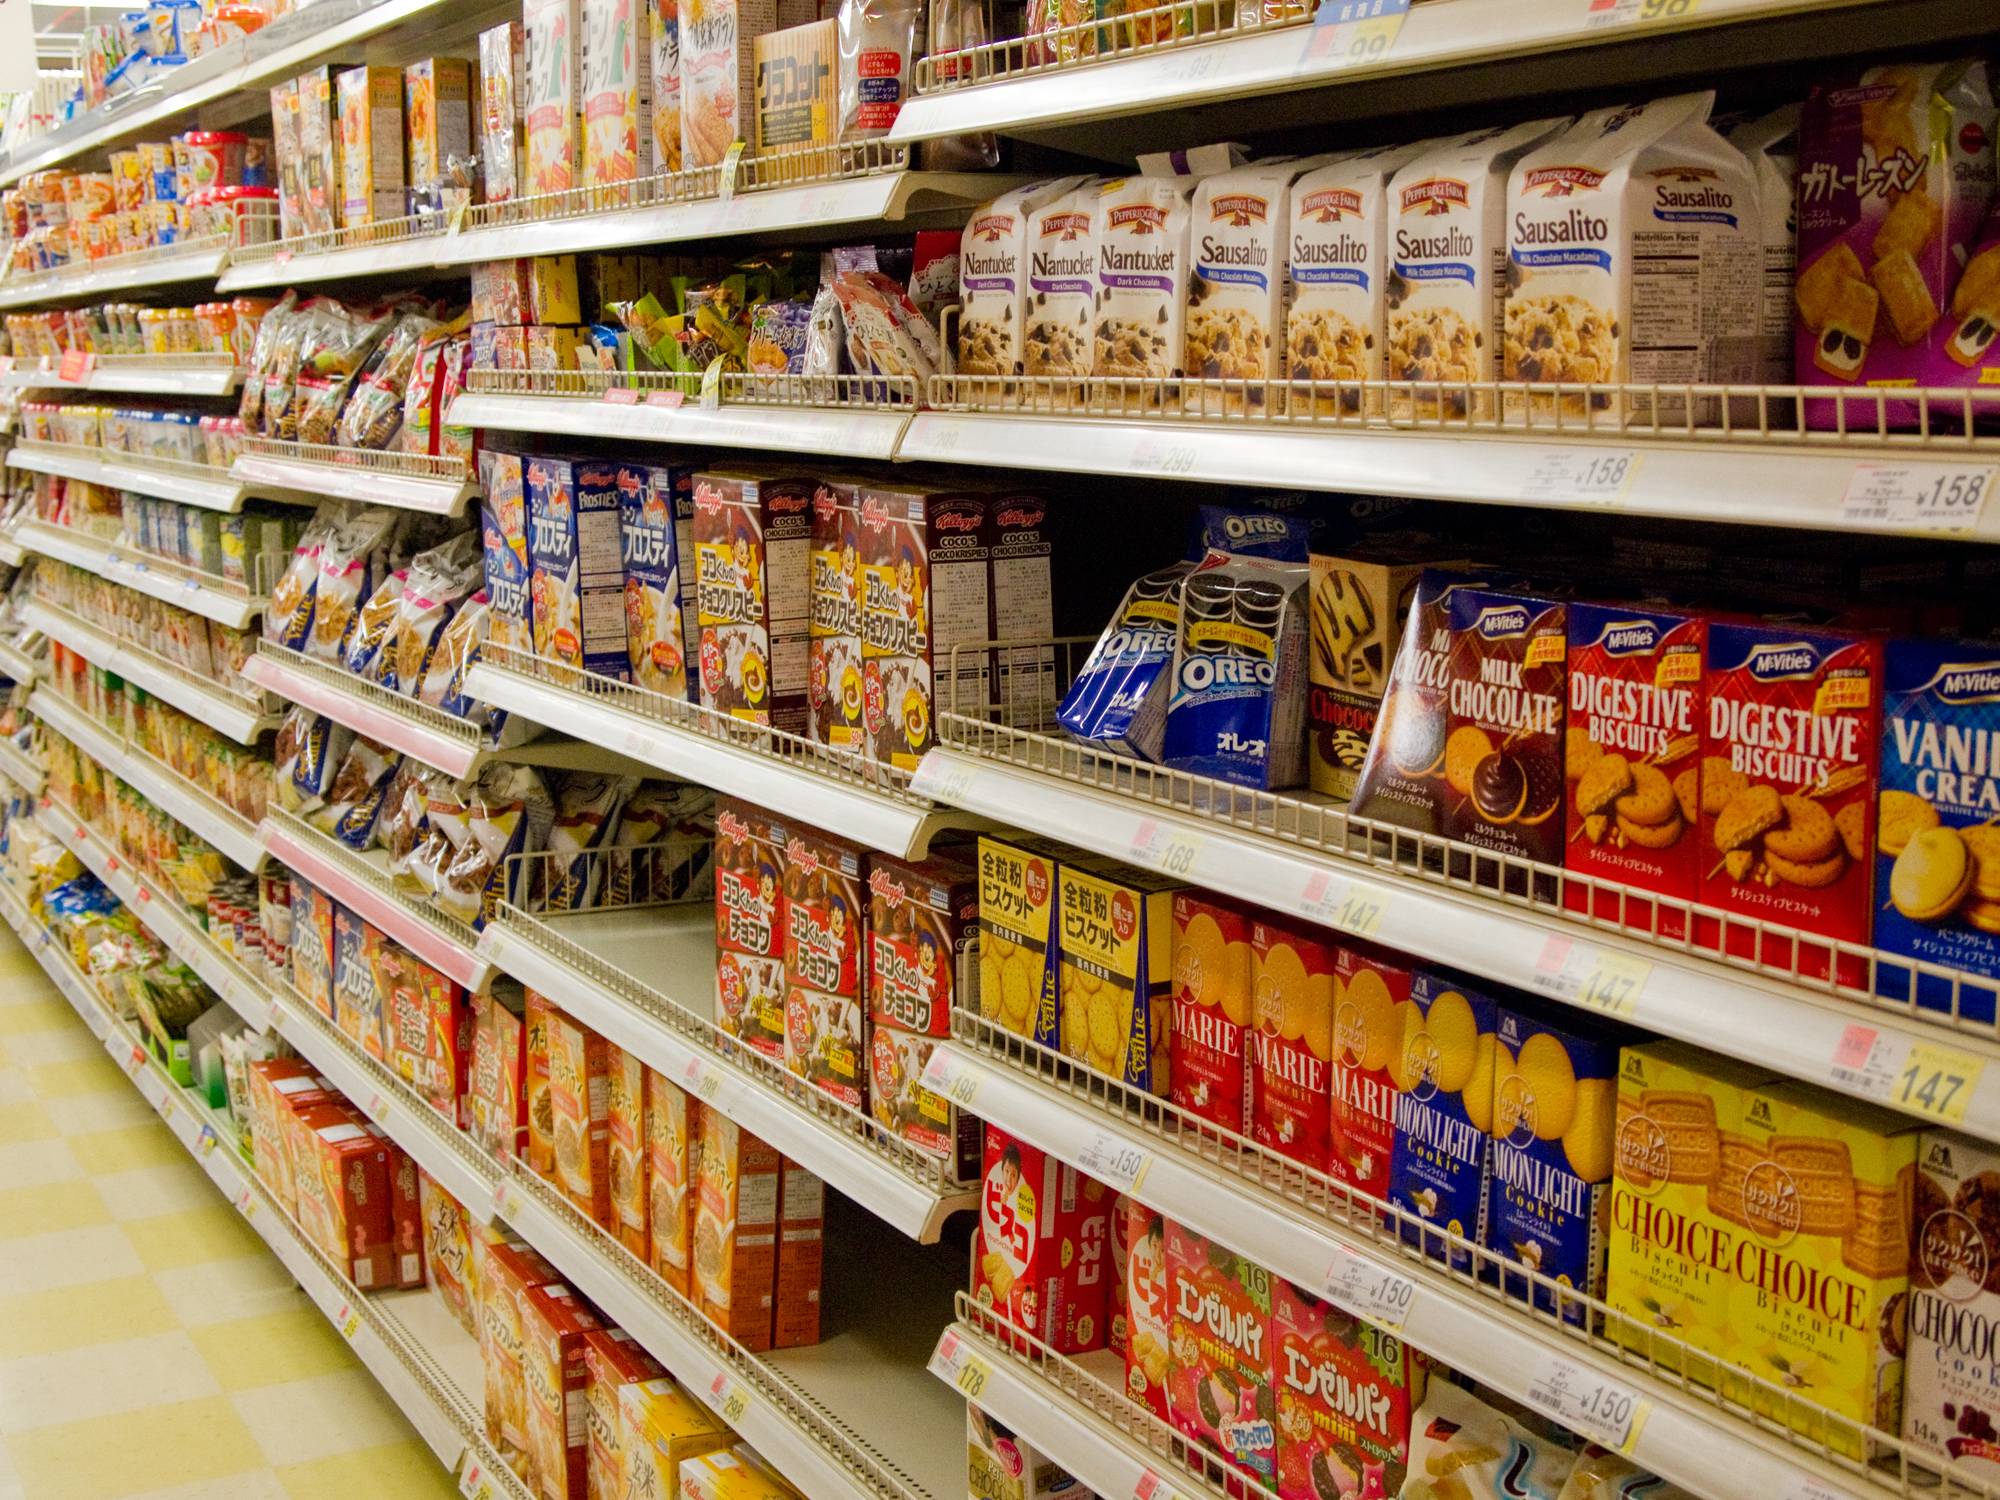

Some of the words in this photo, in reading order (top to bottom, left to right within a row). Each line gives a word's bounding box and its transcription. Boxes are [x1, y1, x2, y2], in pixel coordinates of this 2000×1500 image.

[1405, 184, 1444, 200] PEPPERIDGE
[1445, 184, 1464, 200] FARM
[1801, 146, 1928, 203] ガトーレーズン
[1656, 185, 1733, 209] Sausalito
[1396, 226, 1473, 259] Sausalito
[1514, 208, 1608, 245] Sausalito
[964, 251, 1016, 276] Nantucket
[1032, 251, 1093, 276] Nantucket
[1101, 244, 1175, 272] Nantucket
[1200, 235, 1267, 266] Sausalito
[1294, 234, 1367, 263] Sausalito
[1117, 278, 1132, 286] Dark
[1916, 475, 1985, 507] ¥158
[773, 517, 805, 527] COCO'S
[786, 527, 811, 537] KRISPIE
[936, 512, 982, 531] Kellogg's
[997, 509, 1044, 527] Kellogg's
[1224, 515, 1288, 539] OREO
[531, 517, 573, 558] フロスティ
[622, 525, 670, 568] フロスティ
[930, 548, 955, 560] CHOCO
[955, 547, 988, 559] KRISPIES
[940, 536, 977, 548] COCO'S
[992, 545, 1018, 557] CHOCO
[1018, 543, 1050, 556] KRISPIES
[1002, 532, 1039, 544] COCO'S
[488, 576, 526, 616] フロスティ
[1484, 615, 1525, 632] McVitie's
[1608, 630, 1653, 649] McVitie's
[1182, 657, 1275, 691] OREO
[1481, 656, 1523, 689] MILK
[1756, 651, 1811, 672] McVitie's
[1451, 678, 1557, 735] CHOCOLATE
[1571, 672, 1692, 733] DIGESTIVE
[1217, 733, 1266, 757] オレオ
[1589, 715, 1668, 757] BISCUITS
[1710, 696, 1859, 762] DIGESTIVE
[1892, 717, 2000, 777] VANI
[1731, 745, 1829, 788] BISCUITS
[1916, 769, 2000, 811] CREA
[787, 839, 819, 876] Kellogg's
[982, 851, 1022, 889] 全粒粉
[1162, 843, 1196, 873] 168
[869, 868, 906, 909] Kellogg's
[982, 879, 1034, 920] ビスケット
[1027, 871, 1047, 891] 黒ごま
[1064, 881, 1107, 922] 全粒粉
[1113, 902, 1134, 923] 黒ごま
[1341, 903, 1380, 933] 147
[729, 915, 771, 955] チョコワ
[790, 907, 832, 952] ココくんの
[1064, 910, 1121, 954] ビスケット
[1937, 928, 1994, 950] バニラクリーム
[798, 949, 841, 993] チョコワ
[874, 939, 921, 991] ココくんの
[883, 983, 931, 1035] チョコワ
[1584, 972, 1636, 1010] 147
[1172, 1000, 1237, 1057] MARIE
[1253, 1031, 1323, 1093] MARIE
[951, 1076, 979, 1103] 198
[1902, 1064, 1966, 1114] 147
[1397, 1092, 1478, 1167] MOONLIGHT
[1110, 1150, 1142, 1176] ¥150
[1408, 1138, 1460, 1175] Cookie
[1492, 1141, 1585, 1218] MOONLIGHT
[986, 1179, 1030, 1264] ビスコ
[1506, 1187, 1565, 1227] Cookie
[1613, 1188, 1732, 1274] CHOICE
[1078, 1215, 1106, 1286] ビスコ
[1631, 1236, 1712, 1285] Biscuit
[1244, 1264, 1266, 1296] 16
[1371, 1278, 1412, 1307] ¥150
[1736, 1239, 1866, 1331] CHOICE
[1175, 1276, 1263, 1361] エンゼルパイ
[1757, 1290, 1844, 1344] Biscuit
[1911, 1290, 2000, 1368] CHOCOC
[1200, 1337, 1235, 1369] mini
[1370, 1327, 1400, 1364] 16
[959, 1364, 984, 1396] 178
[1936, 1346, 2000, 1388] Cook
[723, 1395, 745, 1422] 298
[1284, 1345, 1391, 1436] エンゼルパイ
[1580, 1387, 1631, 1424] ¥150
[1232, 1427, 1272, 1449] マシュマロ
[1313, 1410, 1357, 1445] mini
